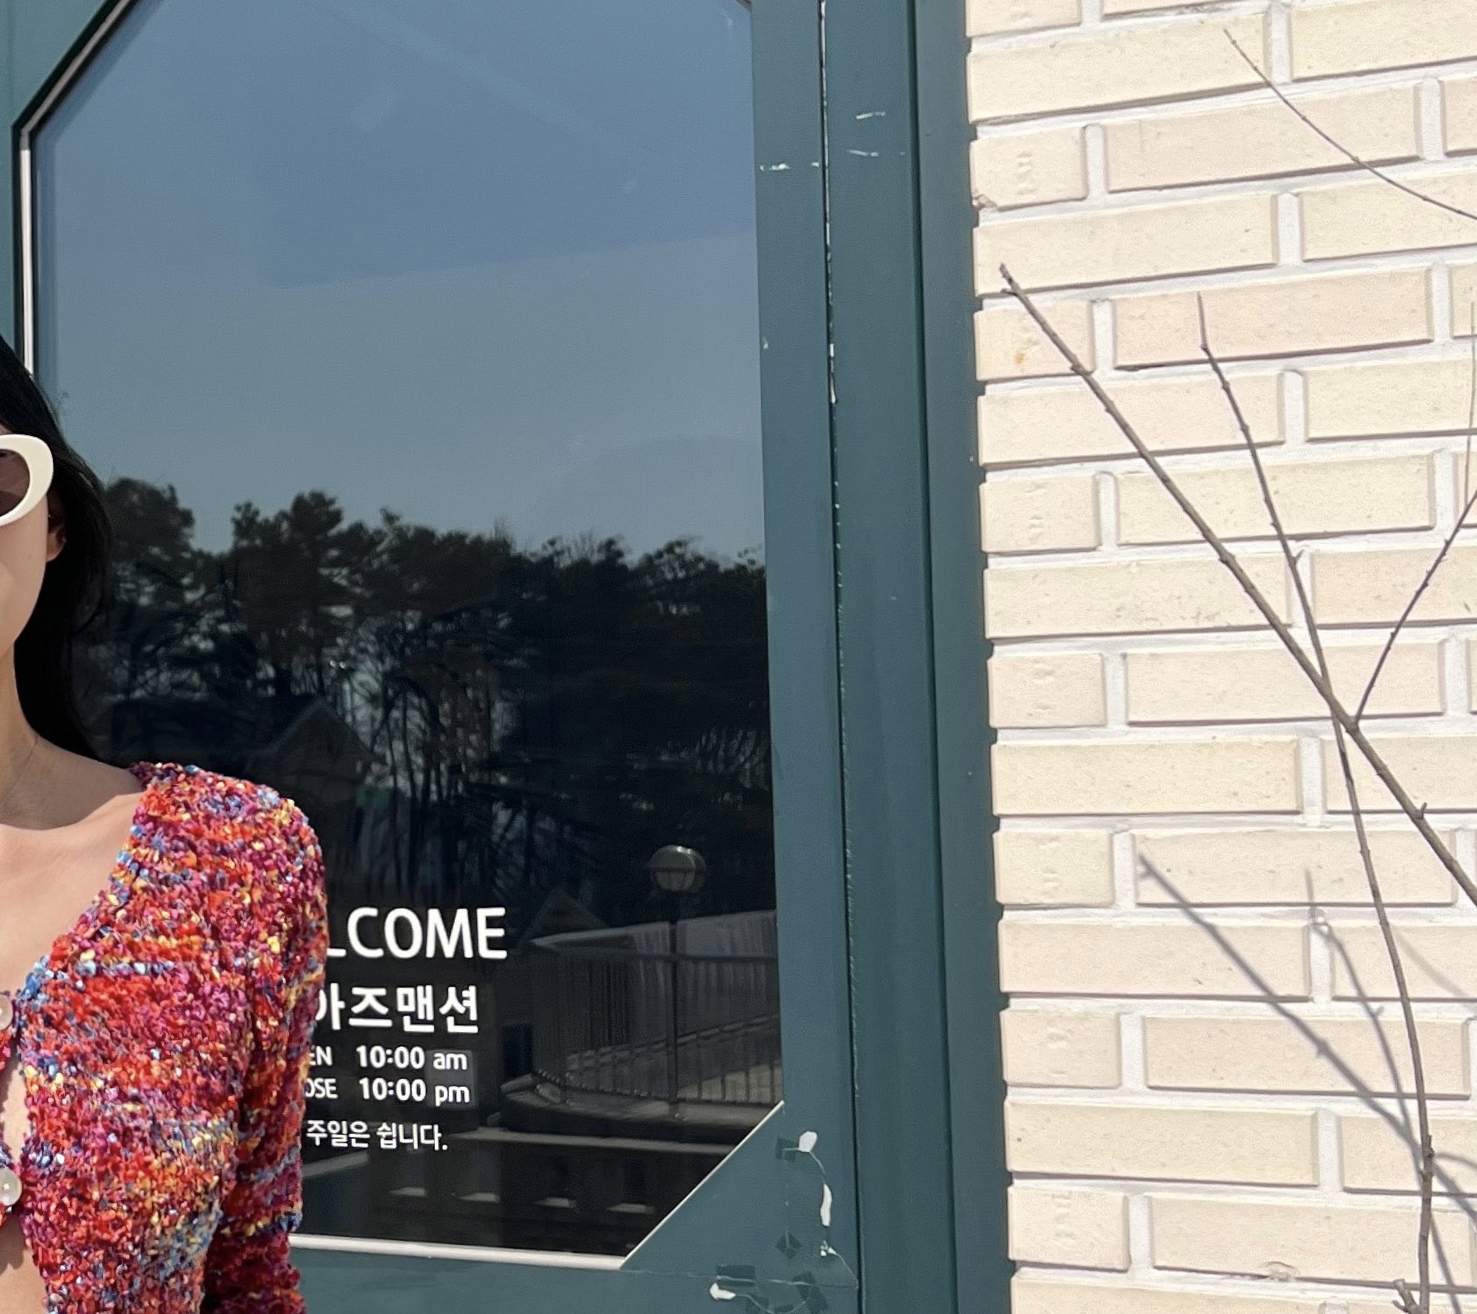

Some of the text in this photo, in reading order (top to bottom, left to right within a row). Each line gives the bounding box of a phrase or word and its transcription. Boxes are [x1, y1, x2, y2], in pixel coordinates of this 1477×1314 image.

[355, 1044, 426, 1069] 10:00
[432, 1052, 468, 1071] am
[358, 1076, 427, 1102] 10:00
[434, 1084, 471, 1107] pm
[305, 1119, 449, 1152] 주일은 쉽니다.
